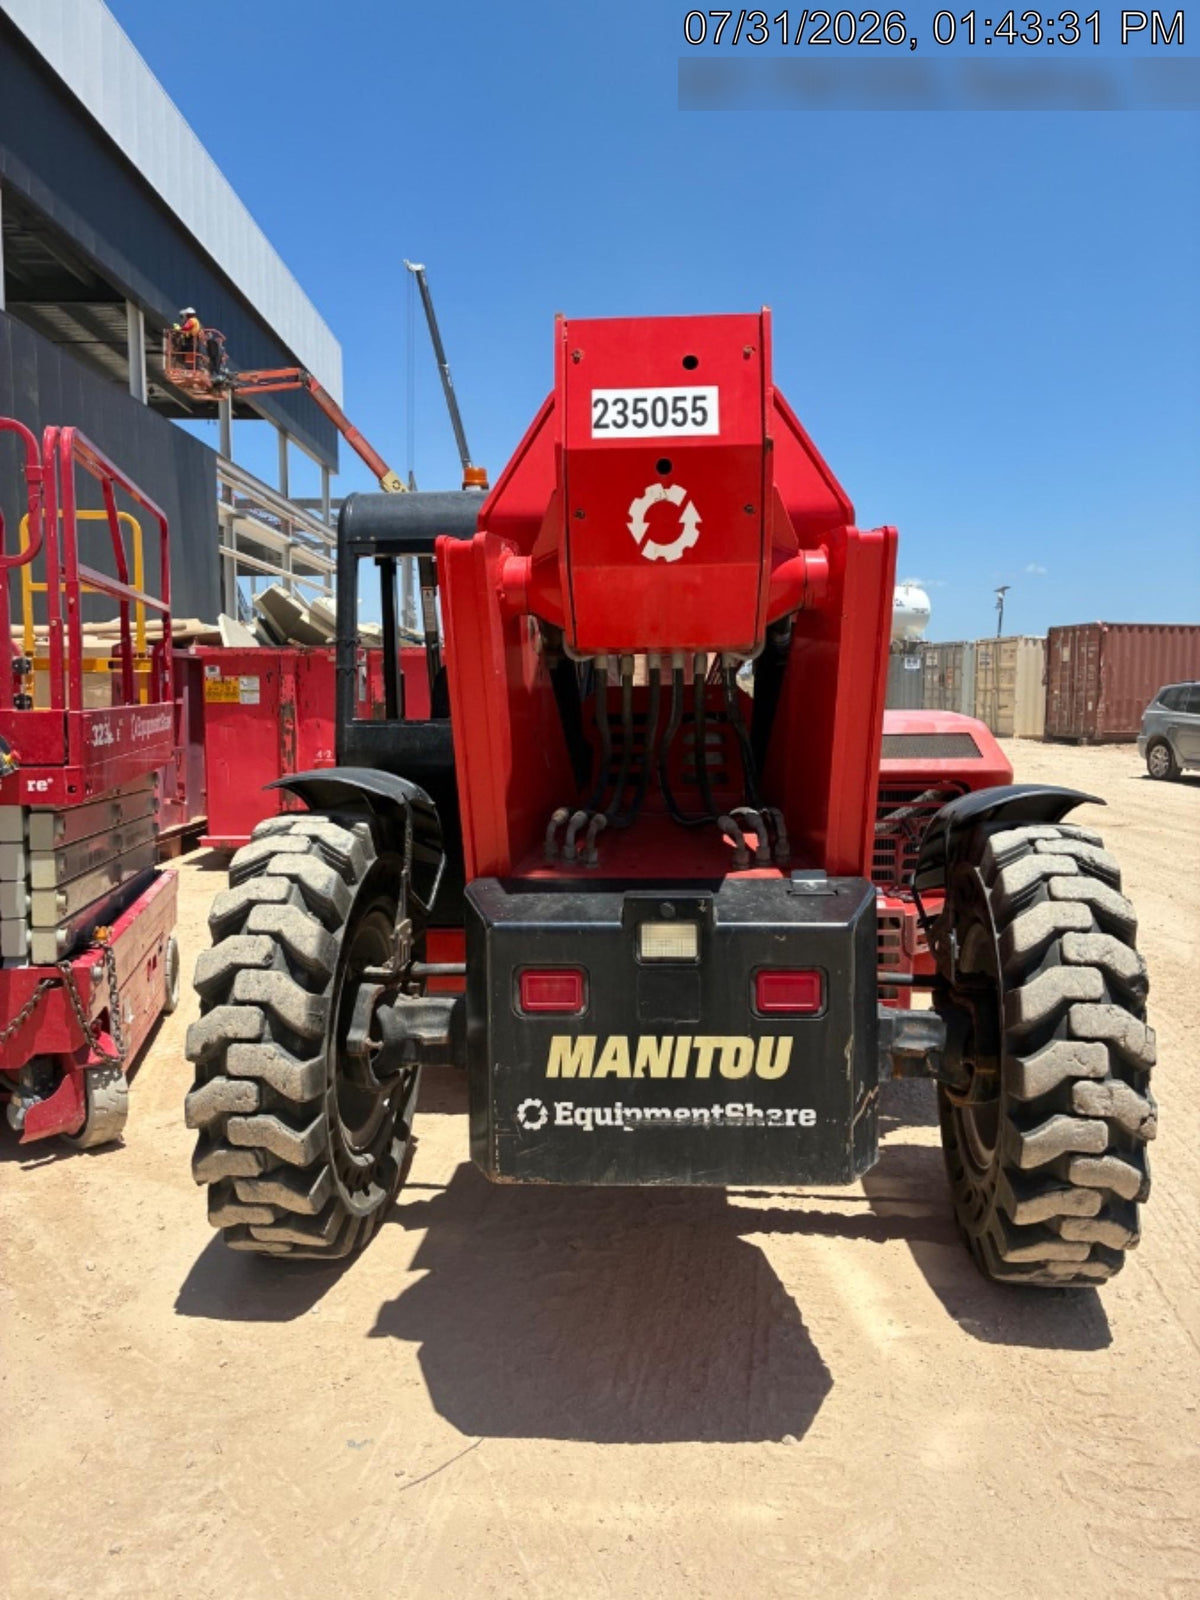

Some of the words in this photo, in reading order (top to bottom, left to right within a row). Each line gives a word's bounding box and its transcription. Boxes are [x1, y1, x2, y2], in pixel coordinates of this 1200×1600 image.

[592, 395, 708, 429] 235055
[545, 1035, 794, 1080] MANITOU
[553, 1101, 817, 1131] EquipmentShare
